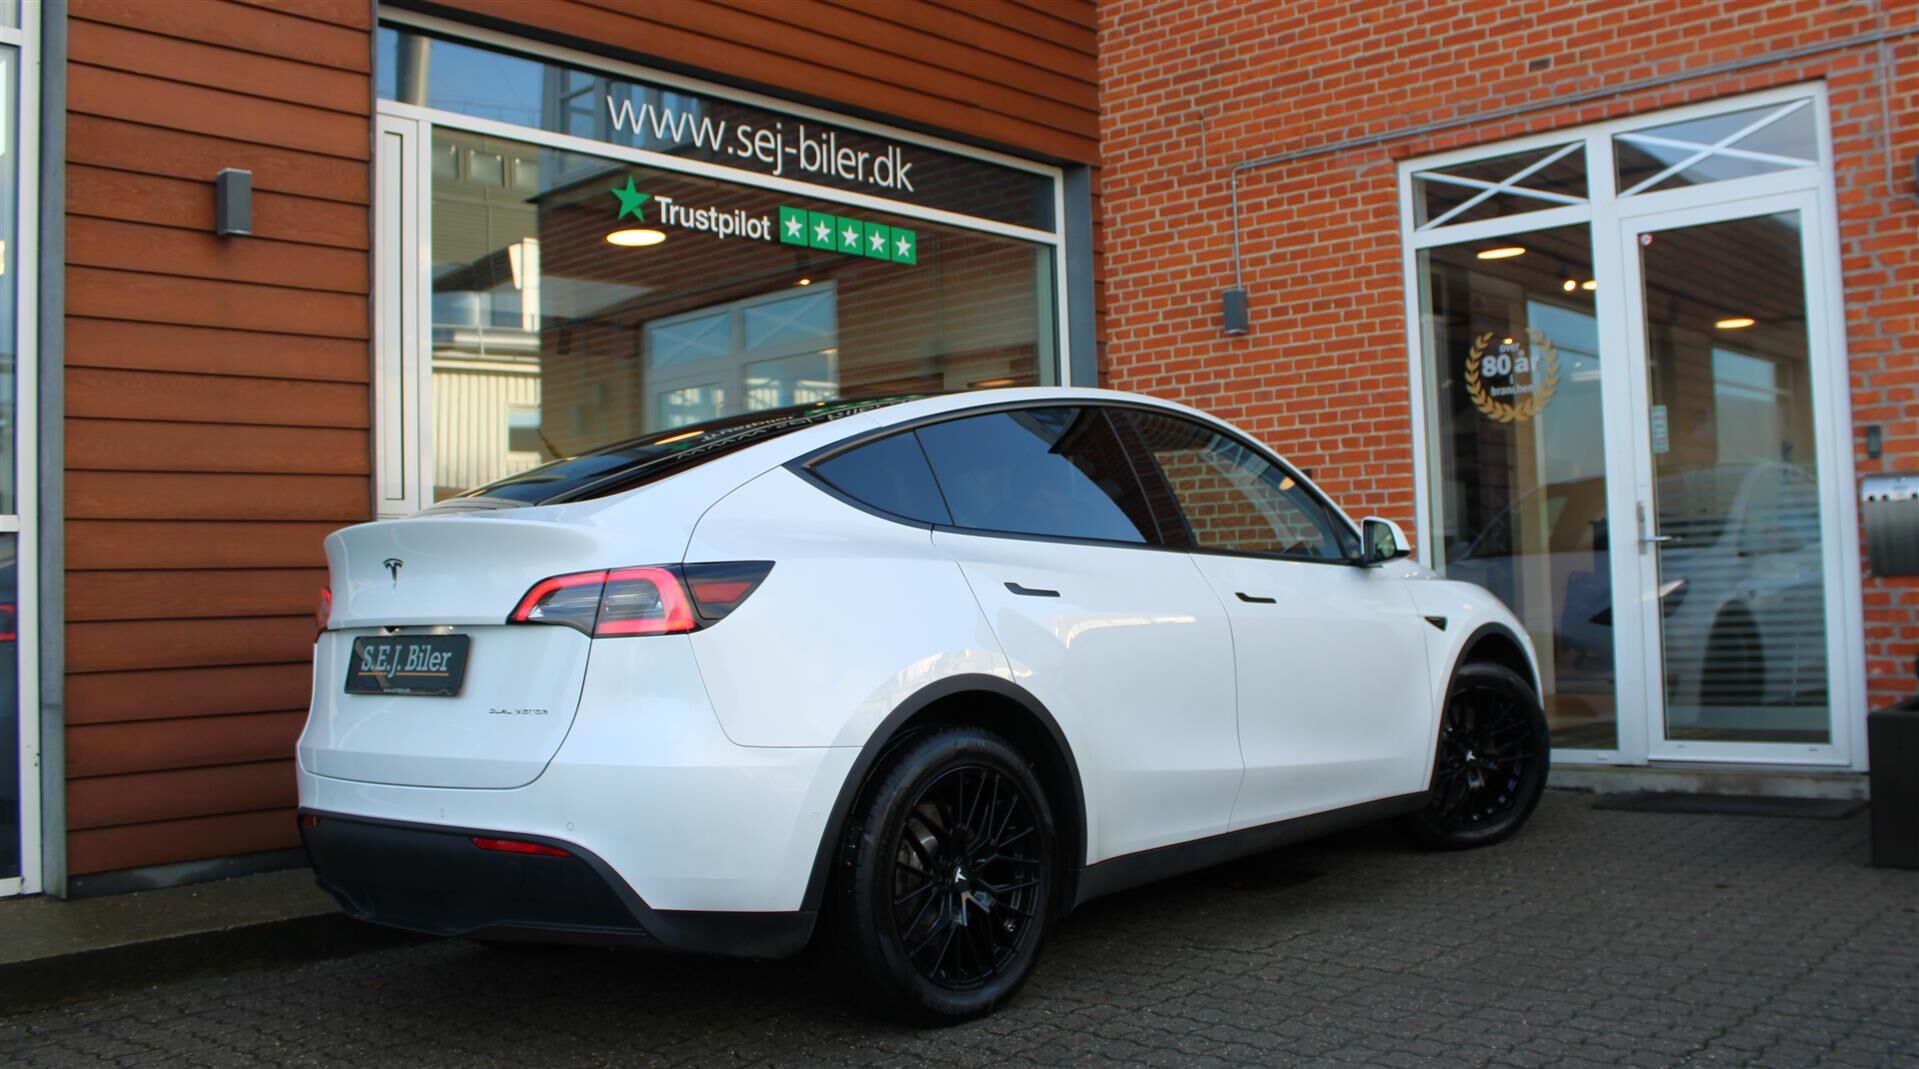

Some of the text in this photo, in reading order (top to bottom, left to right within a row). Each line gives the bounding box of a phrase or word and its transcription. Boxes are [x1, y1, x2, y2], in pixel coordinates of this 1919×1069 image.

[607, 95, 914, 192] www.sej-biler.dk
[654, 195, 772, 240] Trustpilot
[1481, 349, 1540, 377] 80 år
[360, 644, 452, 678] S.E.J. Biler
